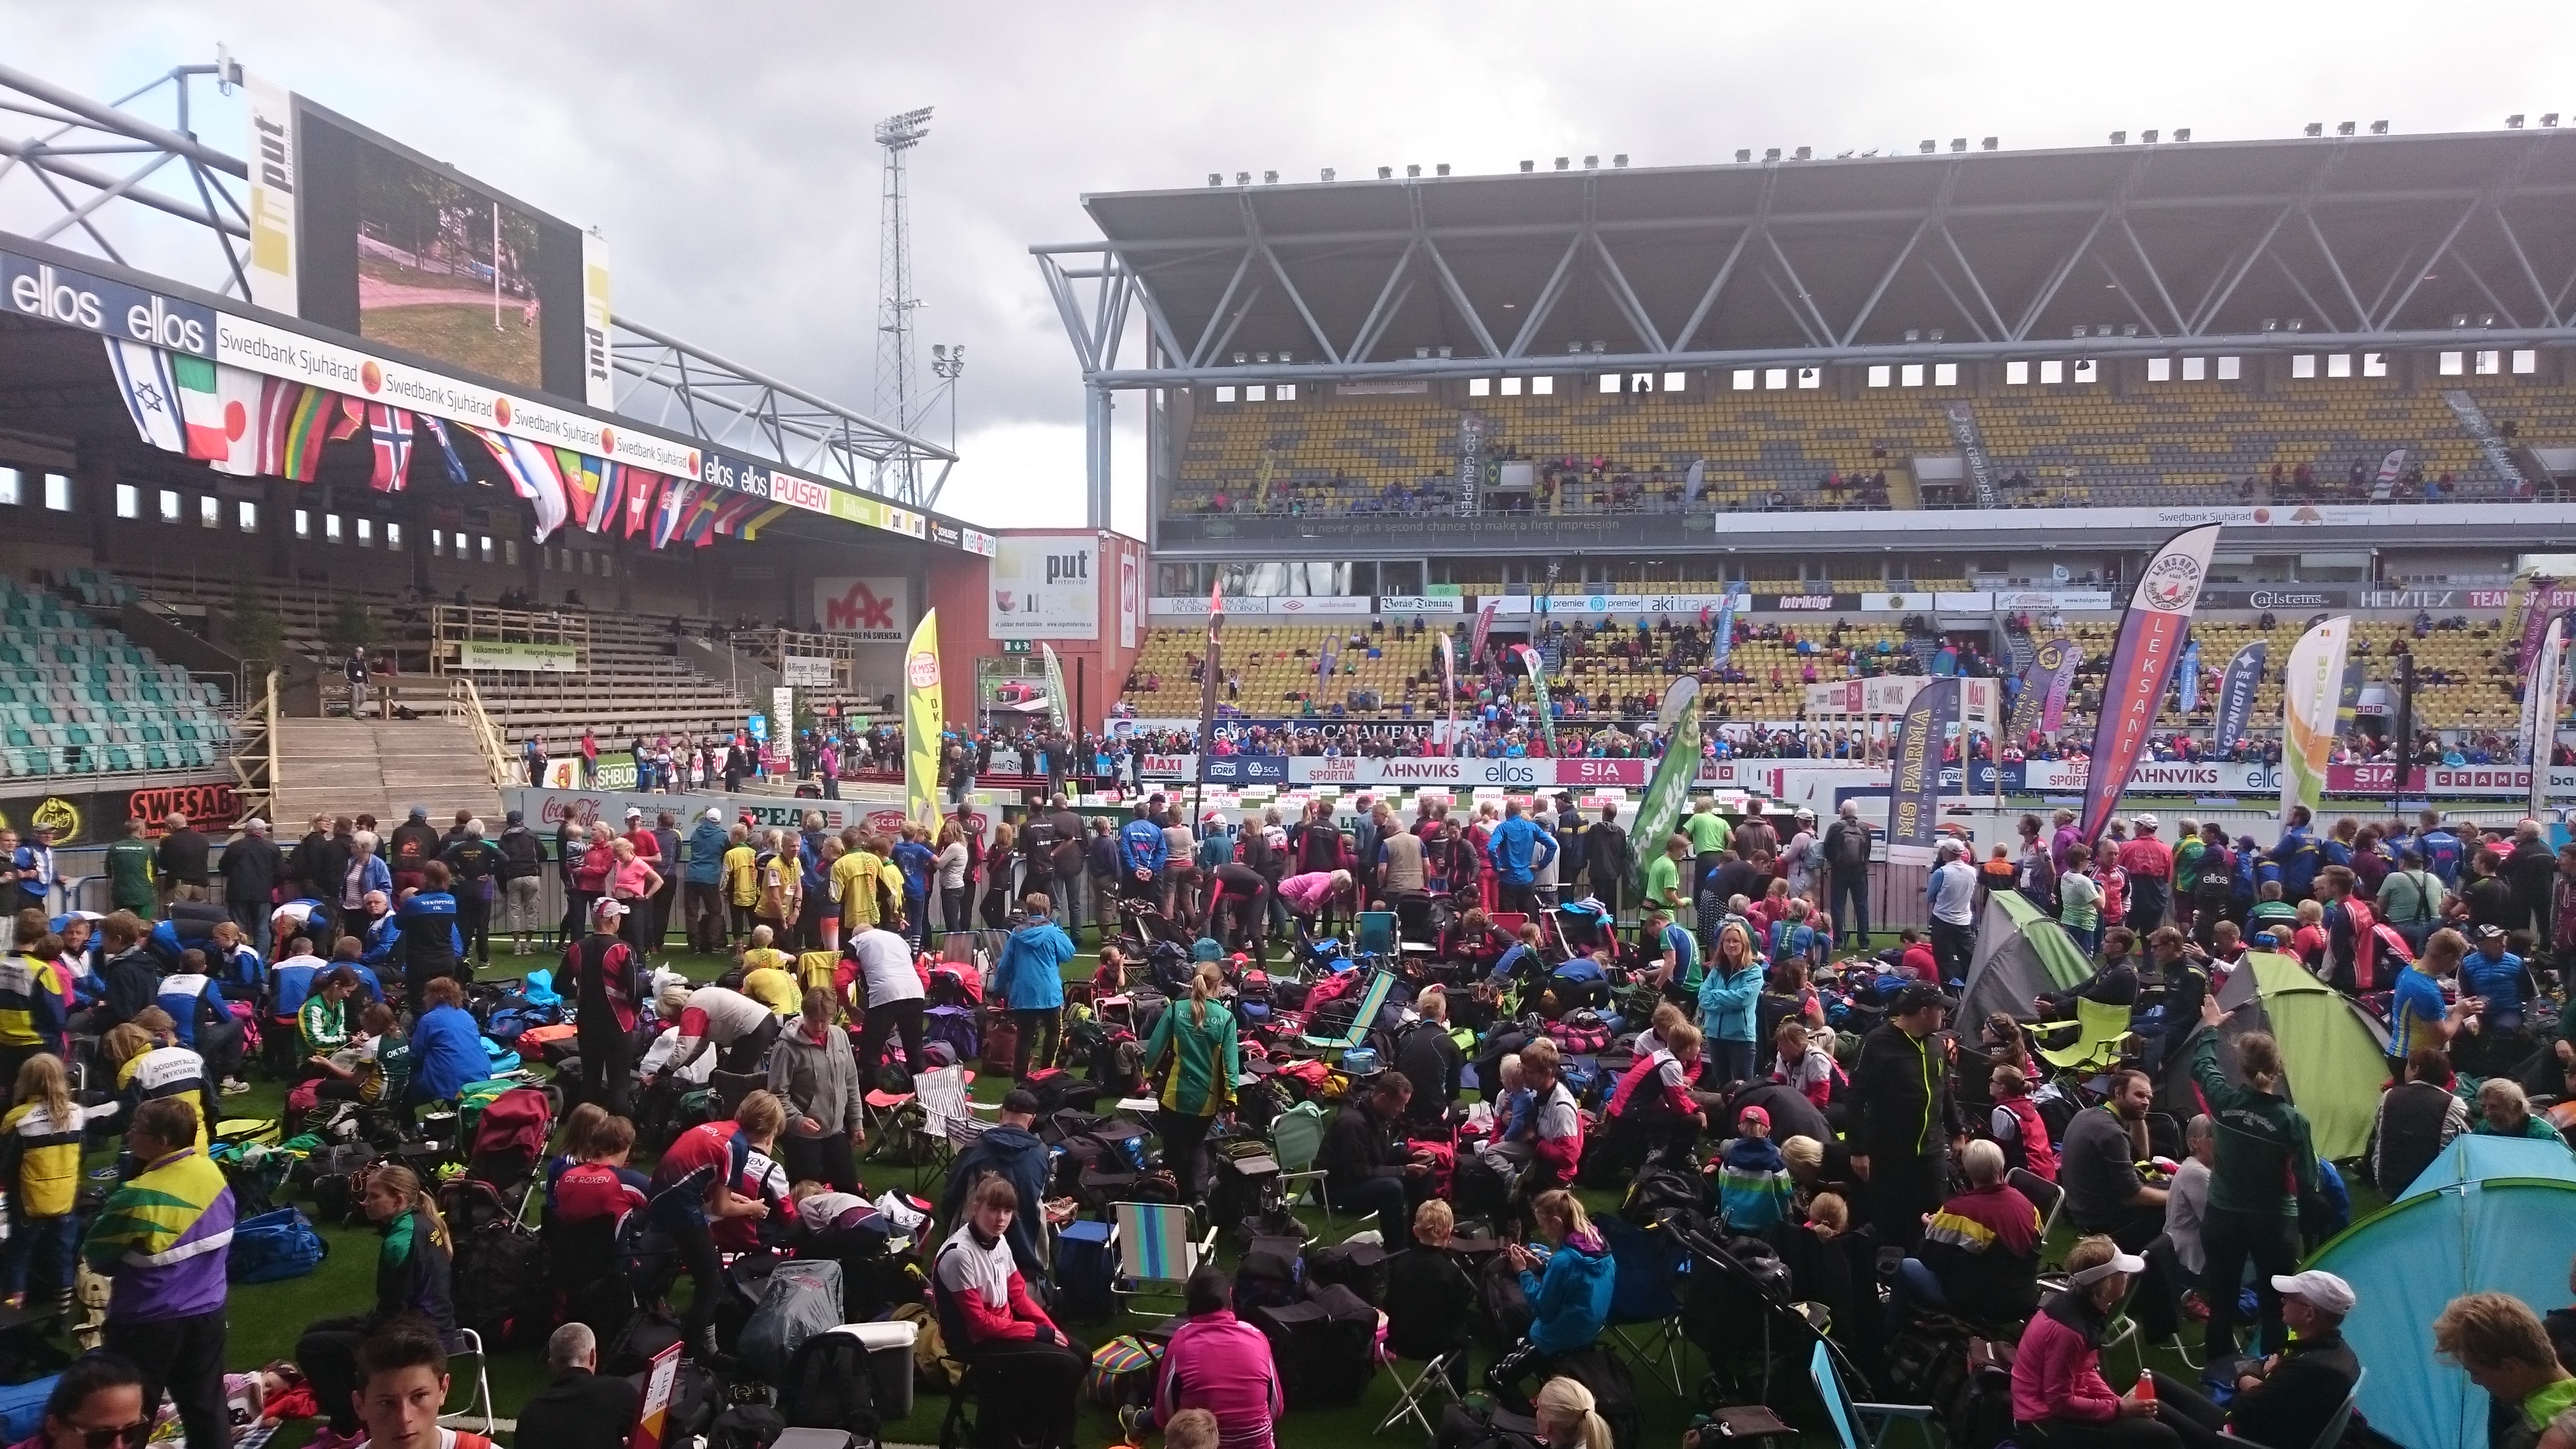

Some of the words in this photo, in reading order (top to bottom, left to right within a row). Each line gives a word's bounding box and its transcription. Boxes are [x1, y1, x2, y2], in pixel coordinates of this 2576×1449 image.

[12, 264, 101, 328] ellos
[127, 295, 204, 353] ellos
[219, 327, 296, 366] Swedbank
[299, 349, 358, 382] Sjuhärad
[386, 374, 444, 405] Swedbank
[447, 391, 492, 417] Sjuhärad
[514, 409, 561, 436] Swedbank
[563, 423, 600, 445] Sjuhärad
[616, 437, 656, 459] Swedbank
[657, 447, 688, 469] Sjuhärad
[705, 455, 734, 488] ellos
[741, 466, 767, 496] ellos
[774, 476, 827, 511] PULSEN
[843, 497, 870, 521] Folksam
[2159, 511, 2208, 521] Swedbank
[2210, 511, 2251, 524] Sjuhärad
[1295, 523, 1314, 533] You
[1318, 524, 1349, 532] never
[1352, 523, 1371, 535] get
[1383, 521, 1423, 532] second
[1426, 521, 1466, 531] chance
[1469, 522, 1482, 530] to
[1486, 520, 1515, 530] make
[1531, 520, 1554, 530] first
[1558, 519, 1619, 532] impression
[826, 582, 893, 629] MAX
[1382, 598, 1414, 610] Borås
[1416, 598, 1452, 610] Tidning
[1553, 599, 1585, 608] premier
[1607, 599, 1640, 608] premier
[1652, 596, 1674, 611] aki
[1779, 595, 1833, 610] fotriktigt
[2361, 591, 2454, 606] HEMTEX
[863, 630, 871, 640] PÅ
[873, 631, 902, 640] SVENSKA
[472, 645, 503, 654] Välkommen
[2235, 671, 2251, 680] IFK
[1883, 686, 1903, 704] AHNVIKS
[1968, 681, 1985, 705] MAXI
[2017, 700, 2039, 736] FALUN
[1322, 723, 1432, 741] CAALIERE
[1900, 709, 1931, 793] PARMA
[1144, 756, 1182, 770] MAXI
[1326, 759, 1355, 770] TEAM
[1580, 762, 1619, 775] SIA
[2068, 763, 2090, 774] TEA
[1309, 771, 1355, 781] SPORTIA
[1381, 764, 1460, 778] AHNVIKS
[1485, 761, 1534, 782] ellos
[2130, 769, 2218, 784] AHNVIKS
[2246, 763, 2282, 788] ello
[2049, 775, 2088, 786] SPORT
[2437, 772, 2530, 786] CRAMO
[131, 786, 235, 822] SWESAB
[750, 806, 828, 828] PEA
[1898, 802, 1918, 837] MS
[2203, 873, 2228, 884] ellos
[1211, 1017, 1222, 1026] OK
[162, 1066, 197, 1079] NYKVARN
[564, 1175, 576, 1183] OK
[579, 1175, 611, 1184] ROXEN
[898, 1216, 909, 1224] OK
